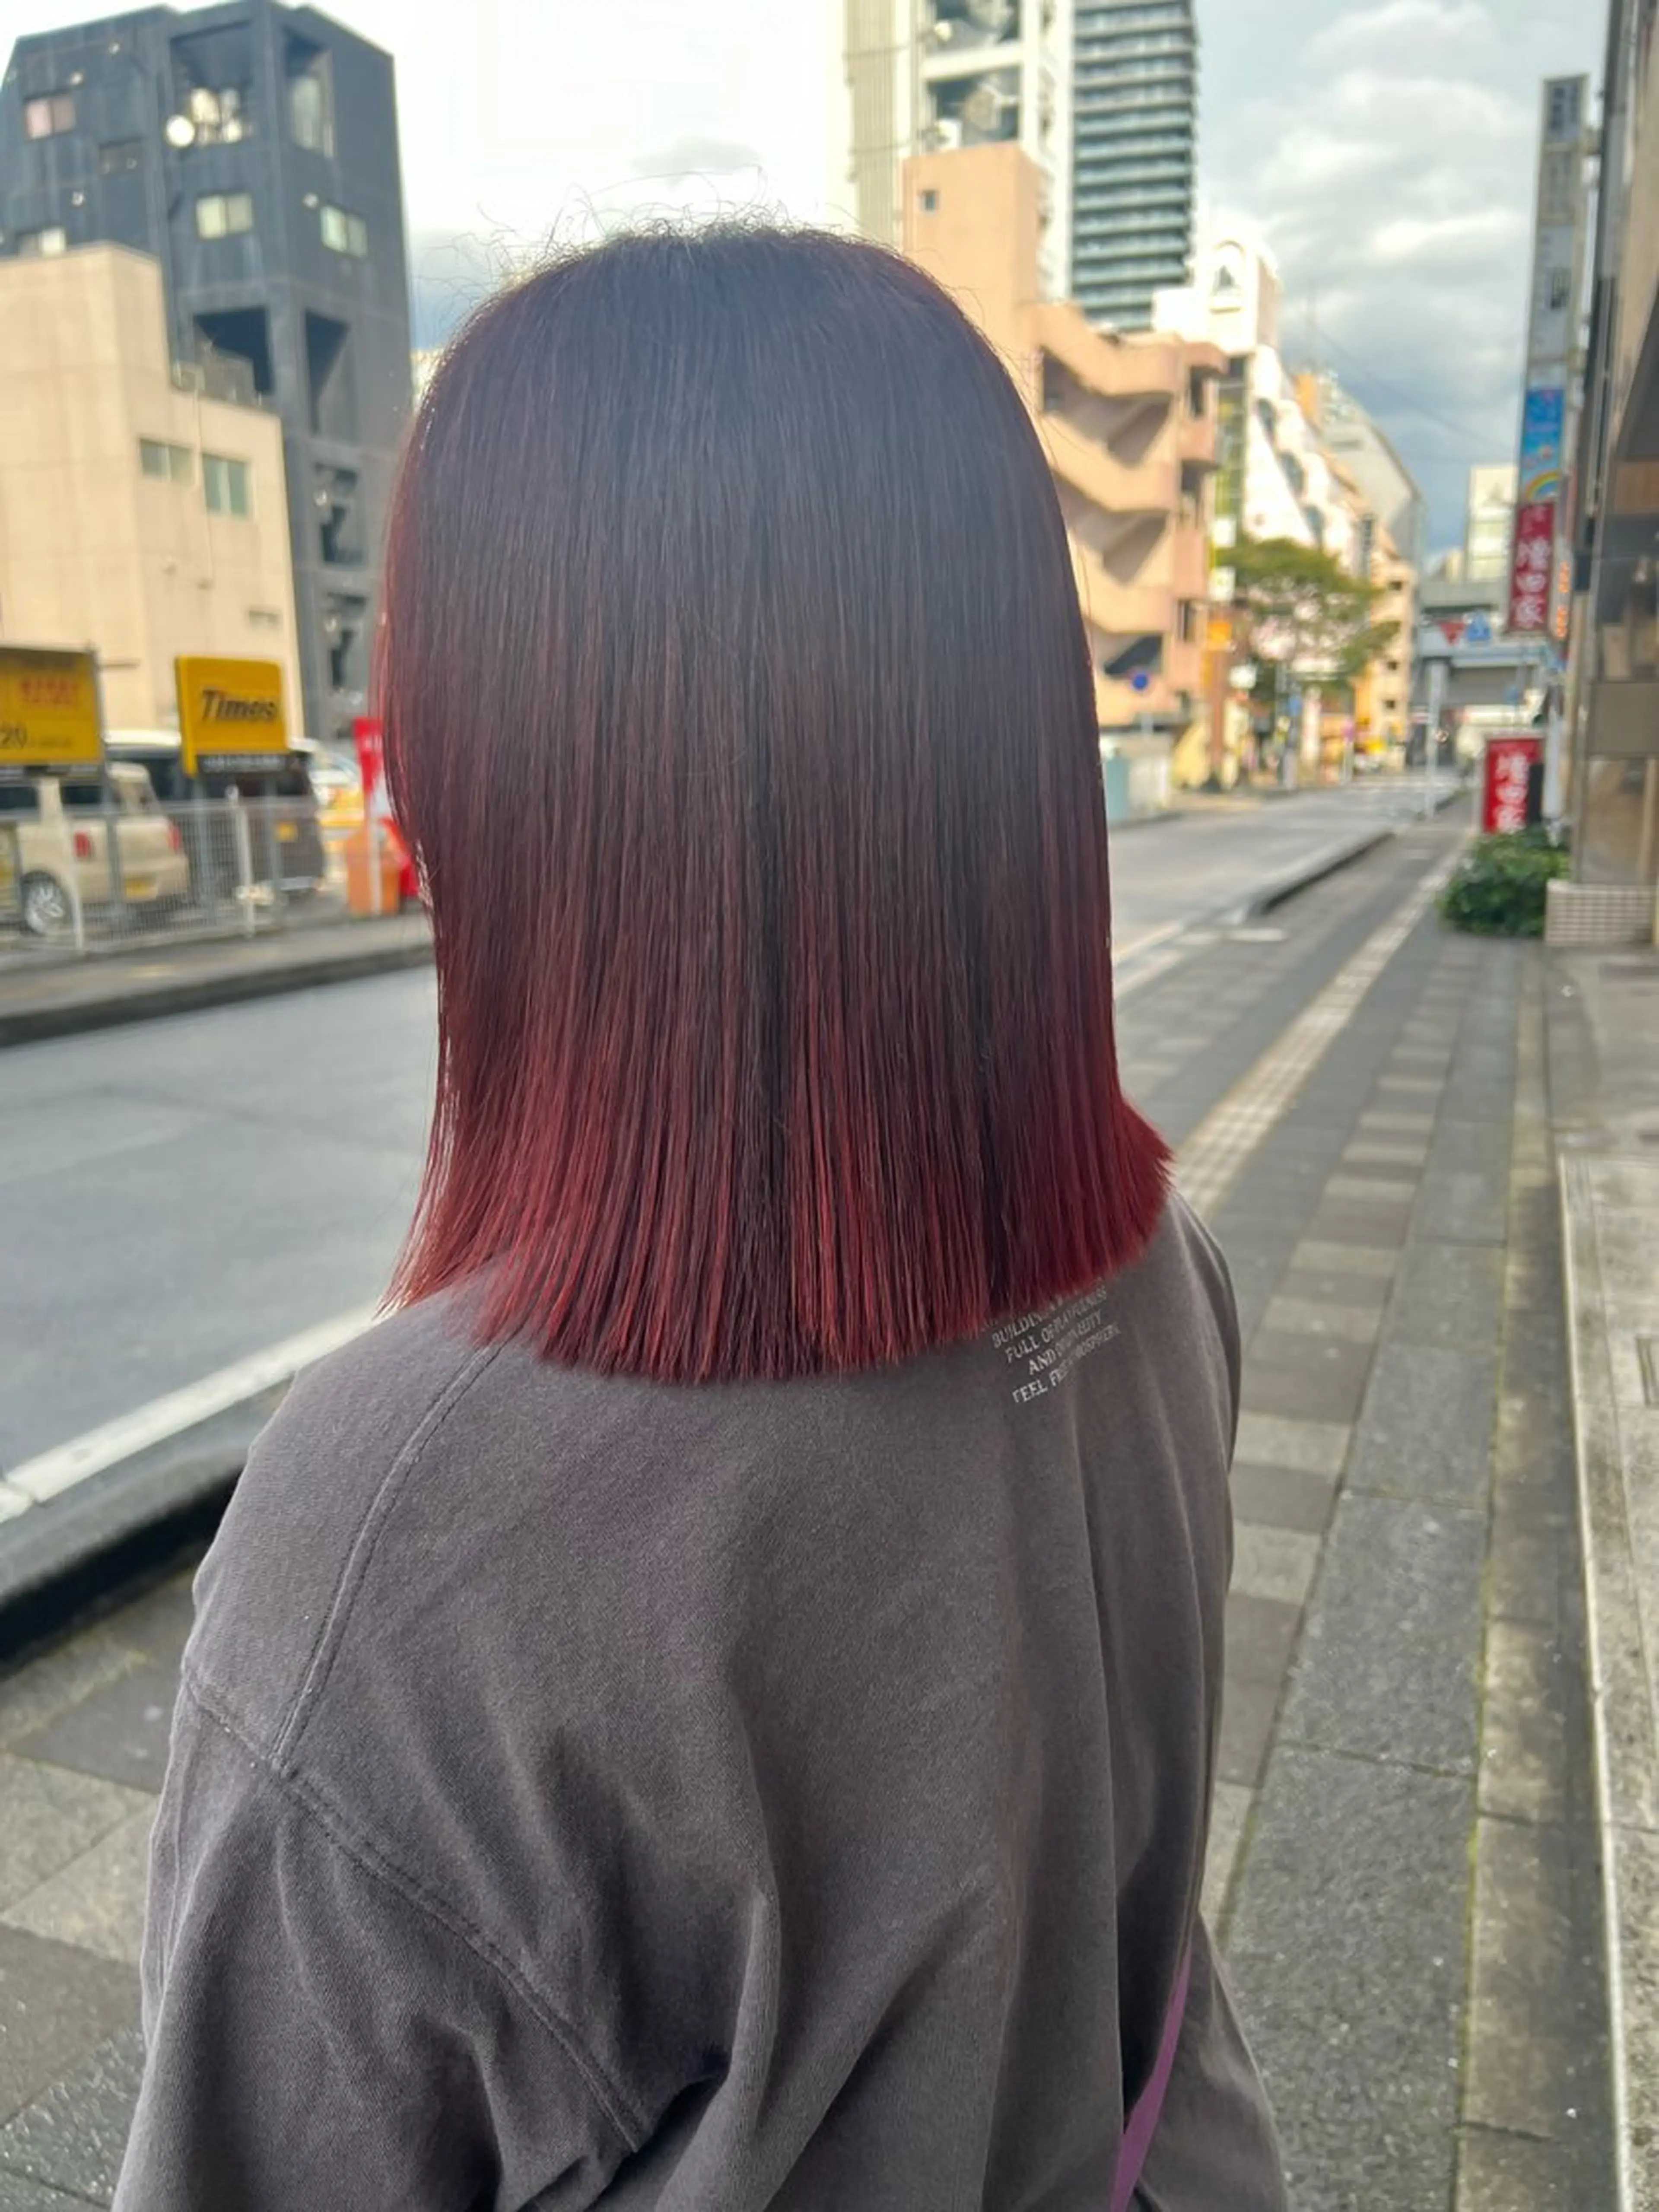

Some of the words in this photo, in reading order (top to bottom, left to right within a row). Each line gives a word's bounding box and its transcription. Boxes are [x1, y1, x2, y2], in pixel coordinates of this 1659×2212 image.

[202, 689, 277, 723] Times
[992, 1310, 1046, 1348] BUILDIN
[1004, 1335, 1040, 1363] FULL
[1041, 1323, 1054, 1343] OF
[1029, 1348, 1057, 1376] AND
[1012, 1379, 1049, 1403] FEEL
